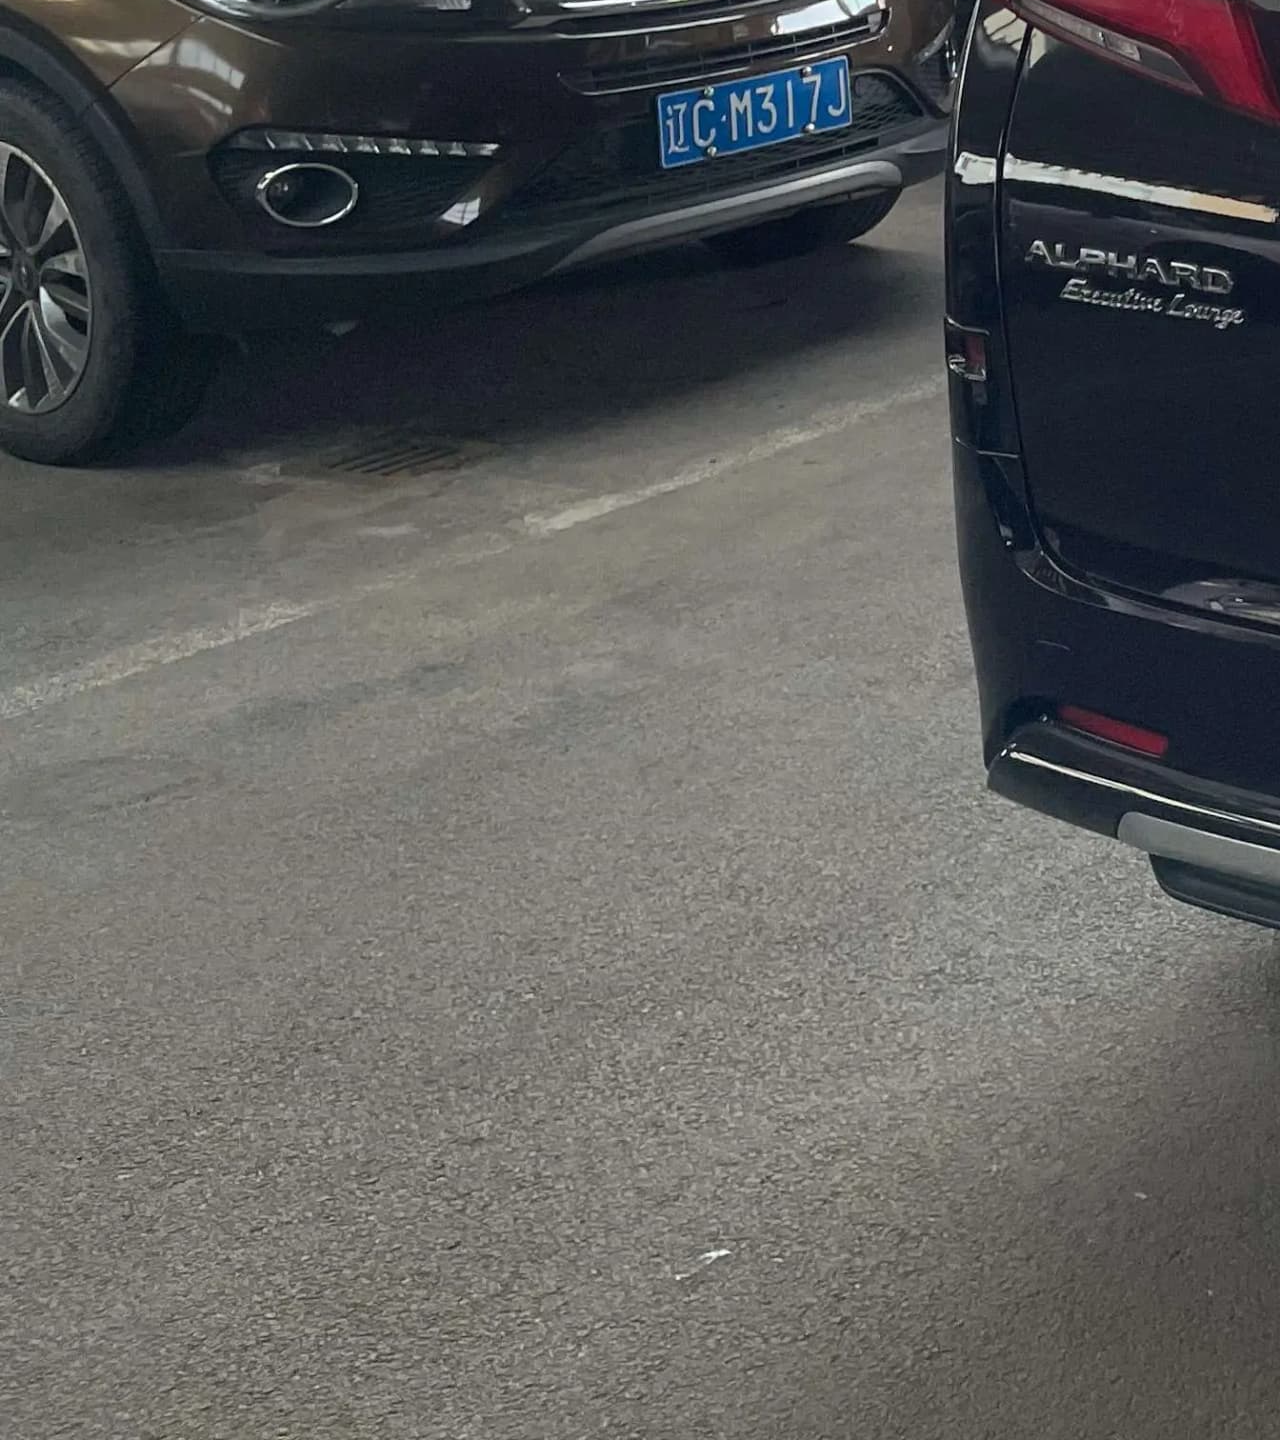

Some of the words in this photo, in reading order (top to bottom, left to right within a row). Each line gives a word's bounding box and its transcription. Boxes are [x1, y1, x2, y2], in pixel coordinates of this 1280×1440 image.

[1024, 239, 1234, 294] ALPHARD
[1059, 277, 1164, 312] Executive
[1166, 292, 1245, 329] Lounge
